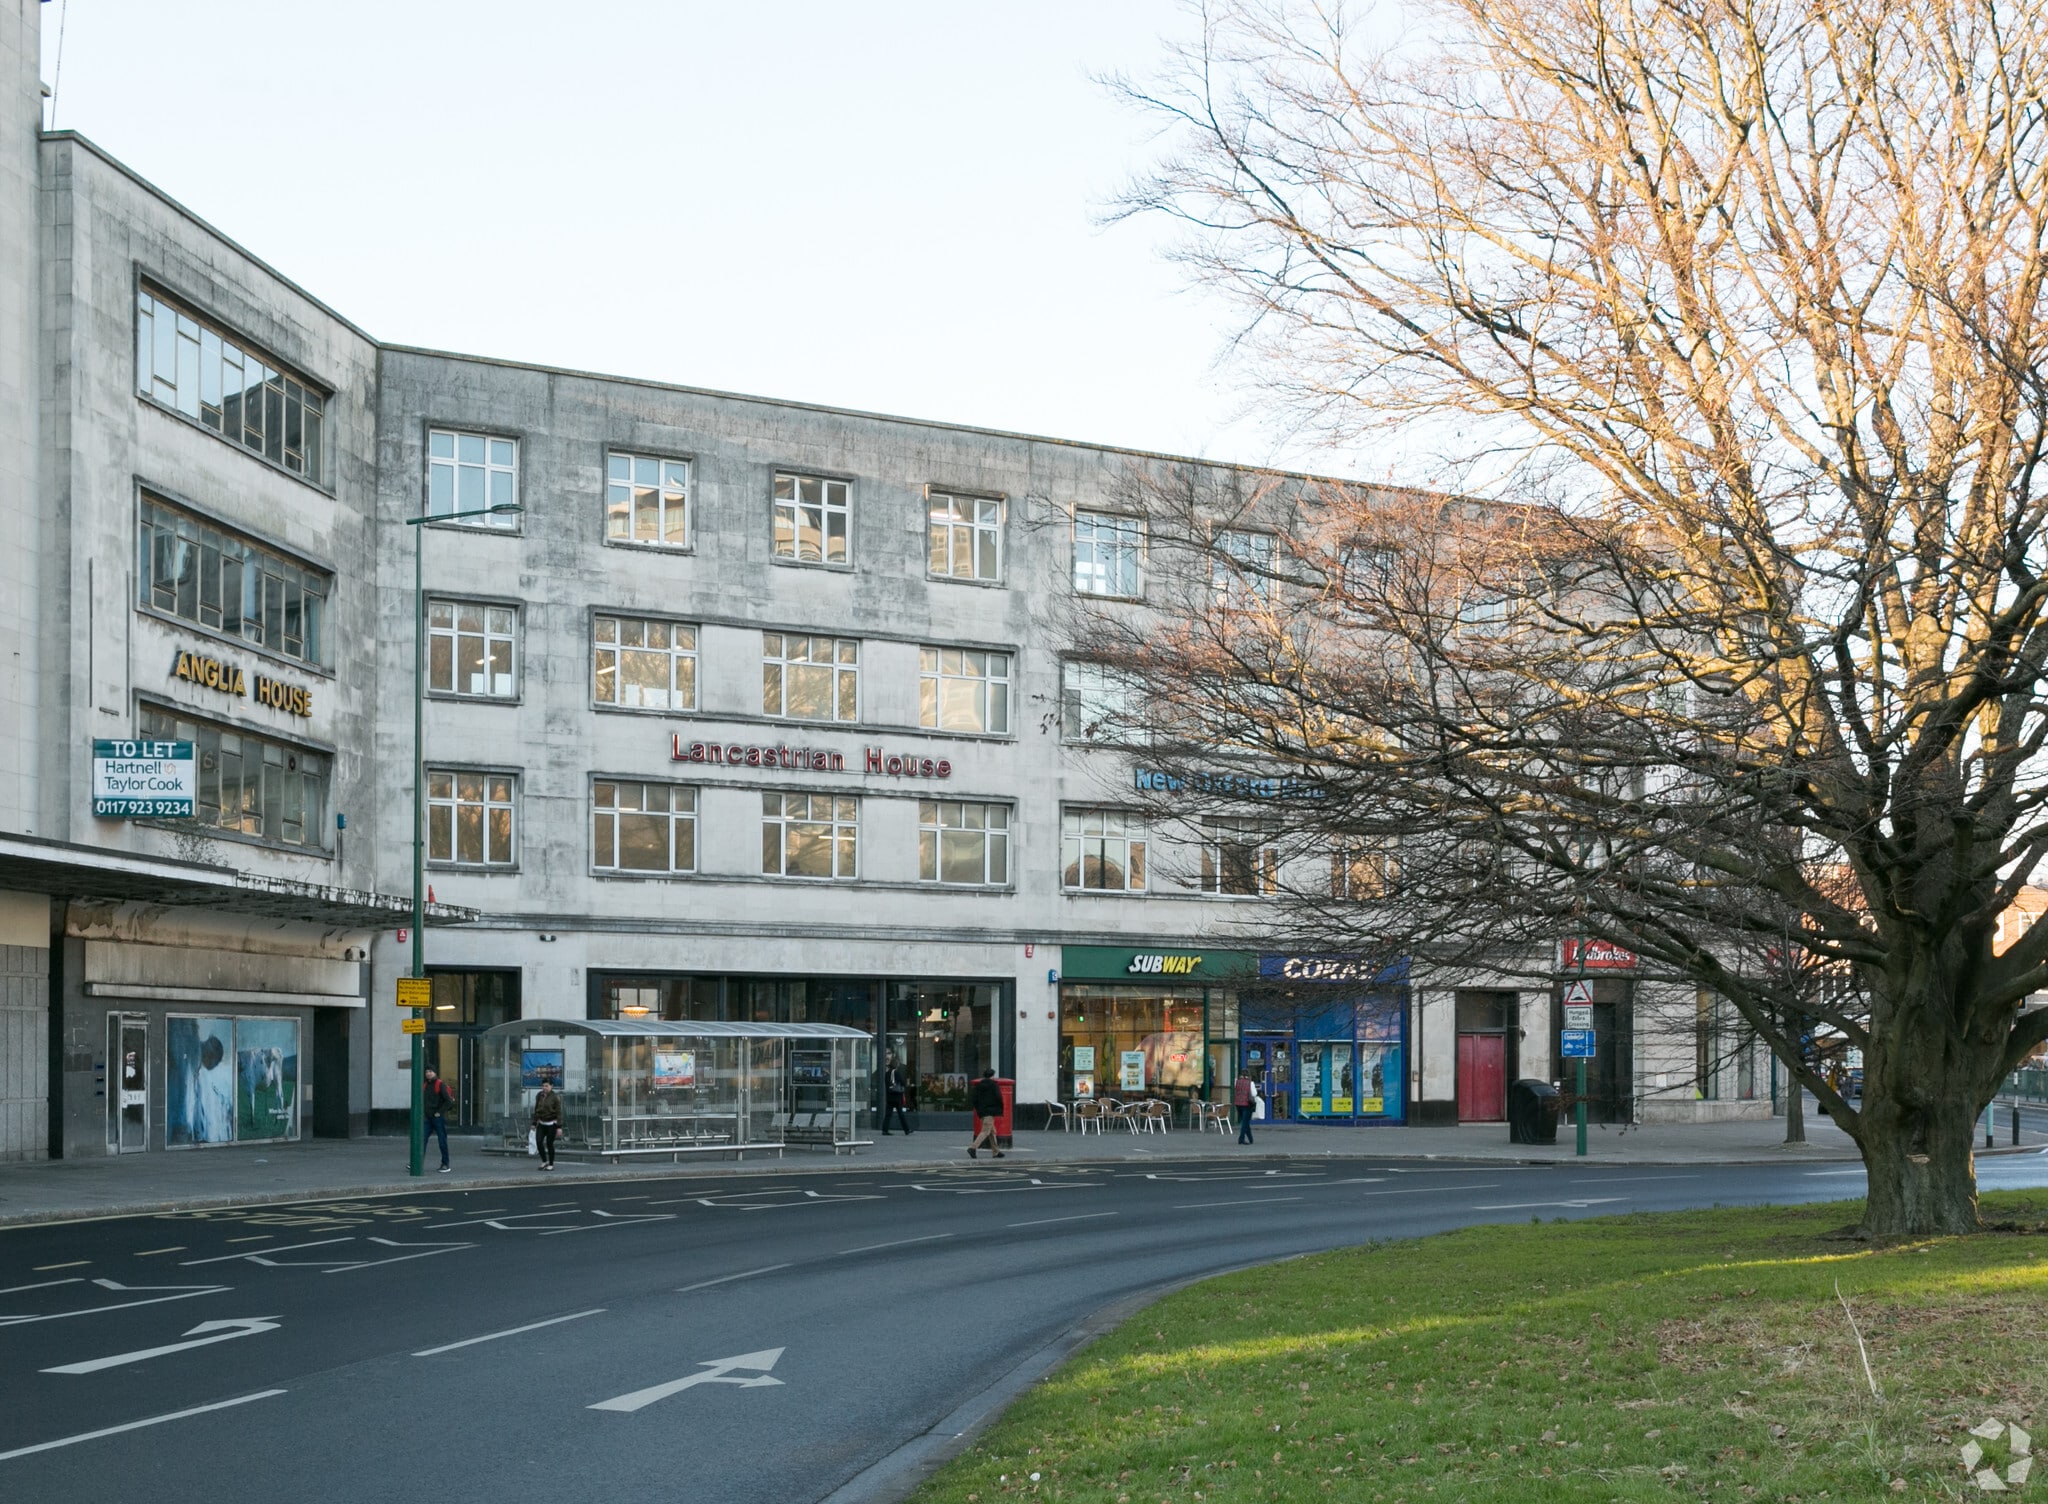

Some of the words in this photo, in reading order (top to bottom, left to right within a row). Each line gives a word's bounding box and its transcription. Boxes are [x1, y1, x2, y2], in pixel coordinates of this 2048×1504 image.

[173, 650, 247, 697] ANGLIA
[256, 675, 313, 718] HOUSE
[111, 741, 137, 757] TO
[142, 741, 177, 758] LET
[671, 733, 846, 771] Lancastrian
[865, 747, 952, 778] House
[105, 760, 161, 775] Hartnell
[104, 776, 147, 793] Taylor
[147, 777, 184, 791] Cook
[96, 800, 127, 814] 0117
[128, 801, 153, 814] 923
[155, 802, 190, 815] 9234
[1572, 946, 1630, 961] Ldbrokes
[1129, 955, 1202, 974] SUBWAY
